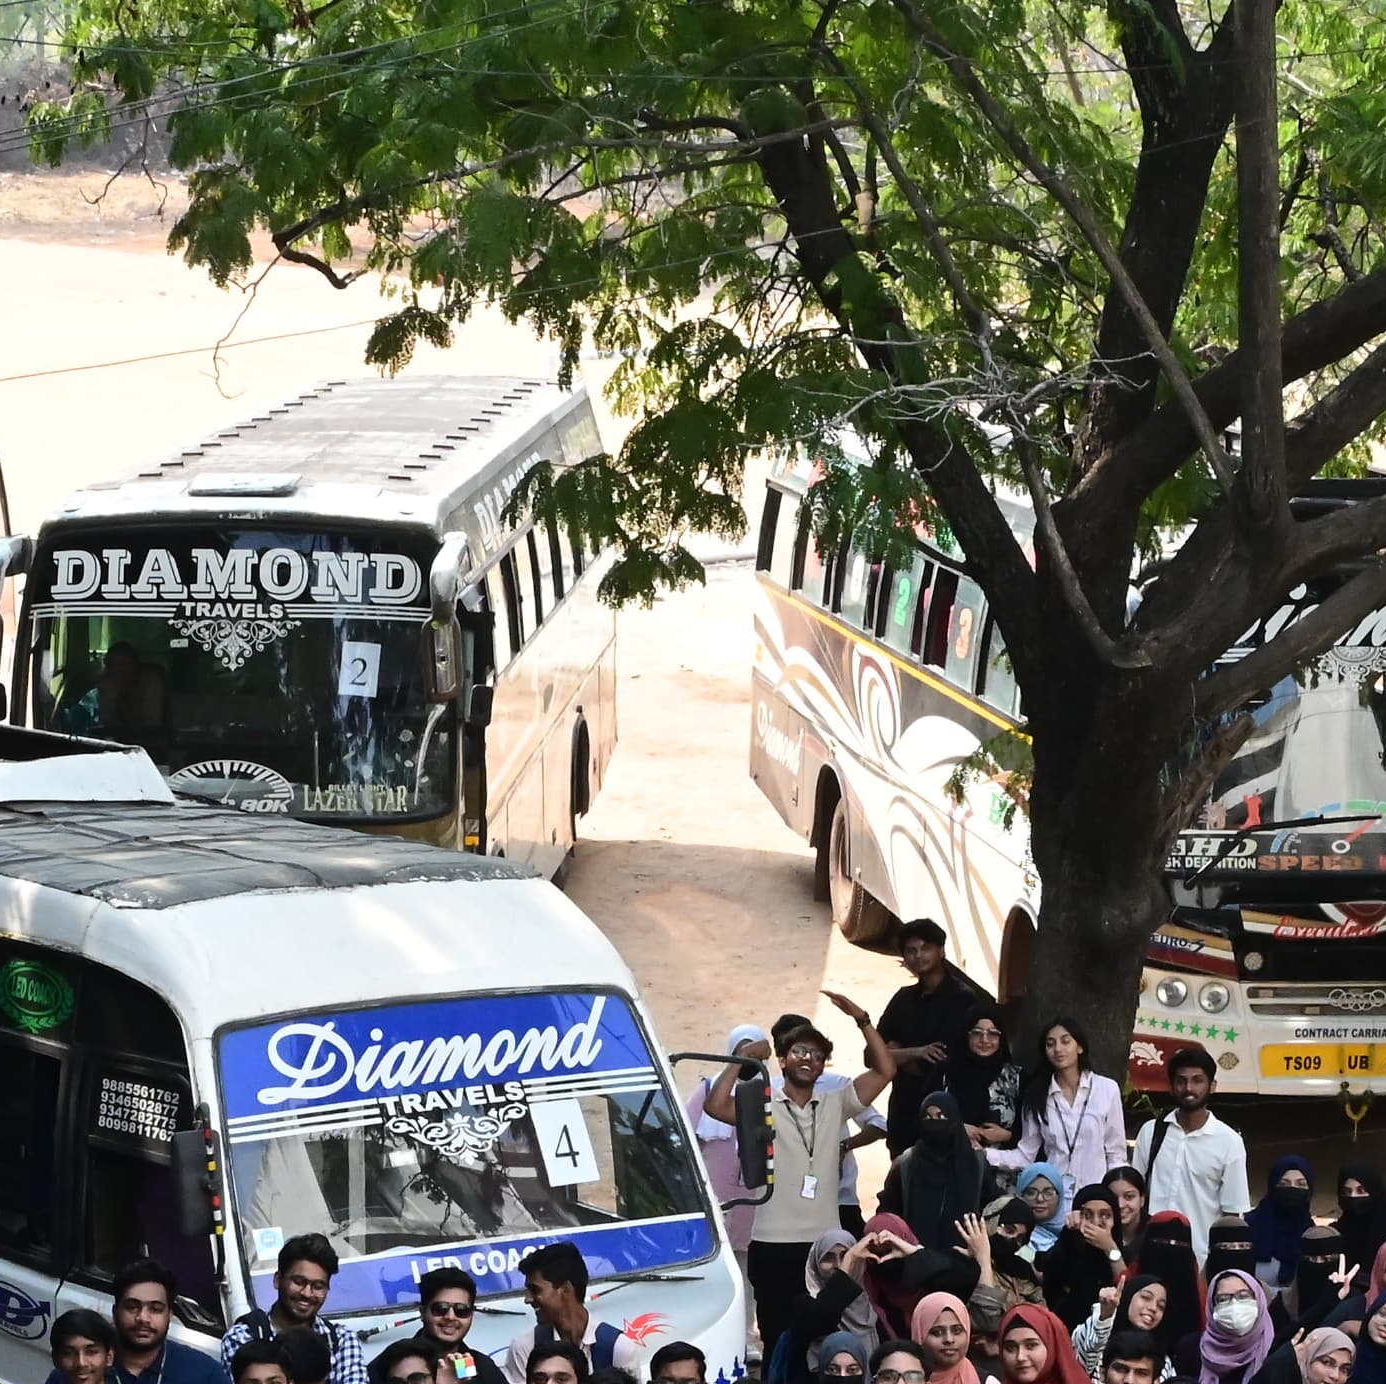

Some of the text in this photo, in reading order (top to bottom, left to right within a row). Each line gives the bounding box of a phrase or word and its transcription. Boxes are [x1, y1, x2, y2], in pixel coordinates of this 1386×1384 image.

[50, 548, 422, 604] DIAMOND
[182, 602, 284, 619] TRAVELS
[350, 657, 368, 686] 2
[303, 785, 359, 813] LAZER
[1294, 1028, 1348, 1038] CONTRACT
[257, 995, 607, 1105] Diamond
[1284, 1056, 1322, 1071] TS09
[1348, 1055, 1370, 1070] UB
[100, 1091, 179, 1118] 9346502877
[102, 1078, 181, 1105] 9885561762
[376, 1081, 526, 1117] TRAVELS
[99, 1103, 177, 1130] 9347282775
[555, 1124, 581, 1168] 4
[470, 1245, 547, 1277] COA
